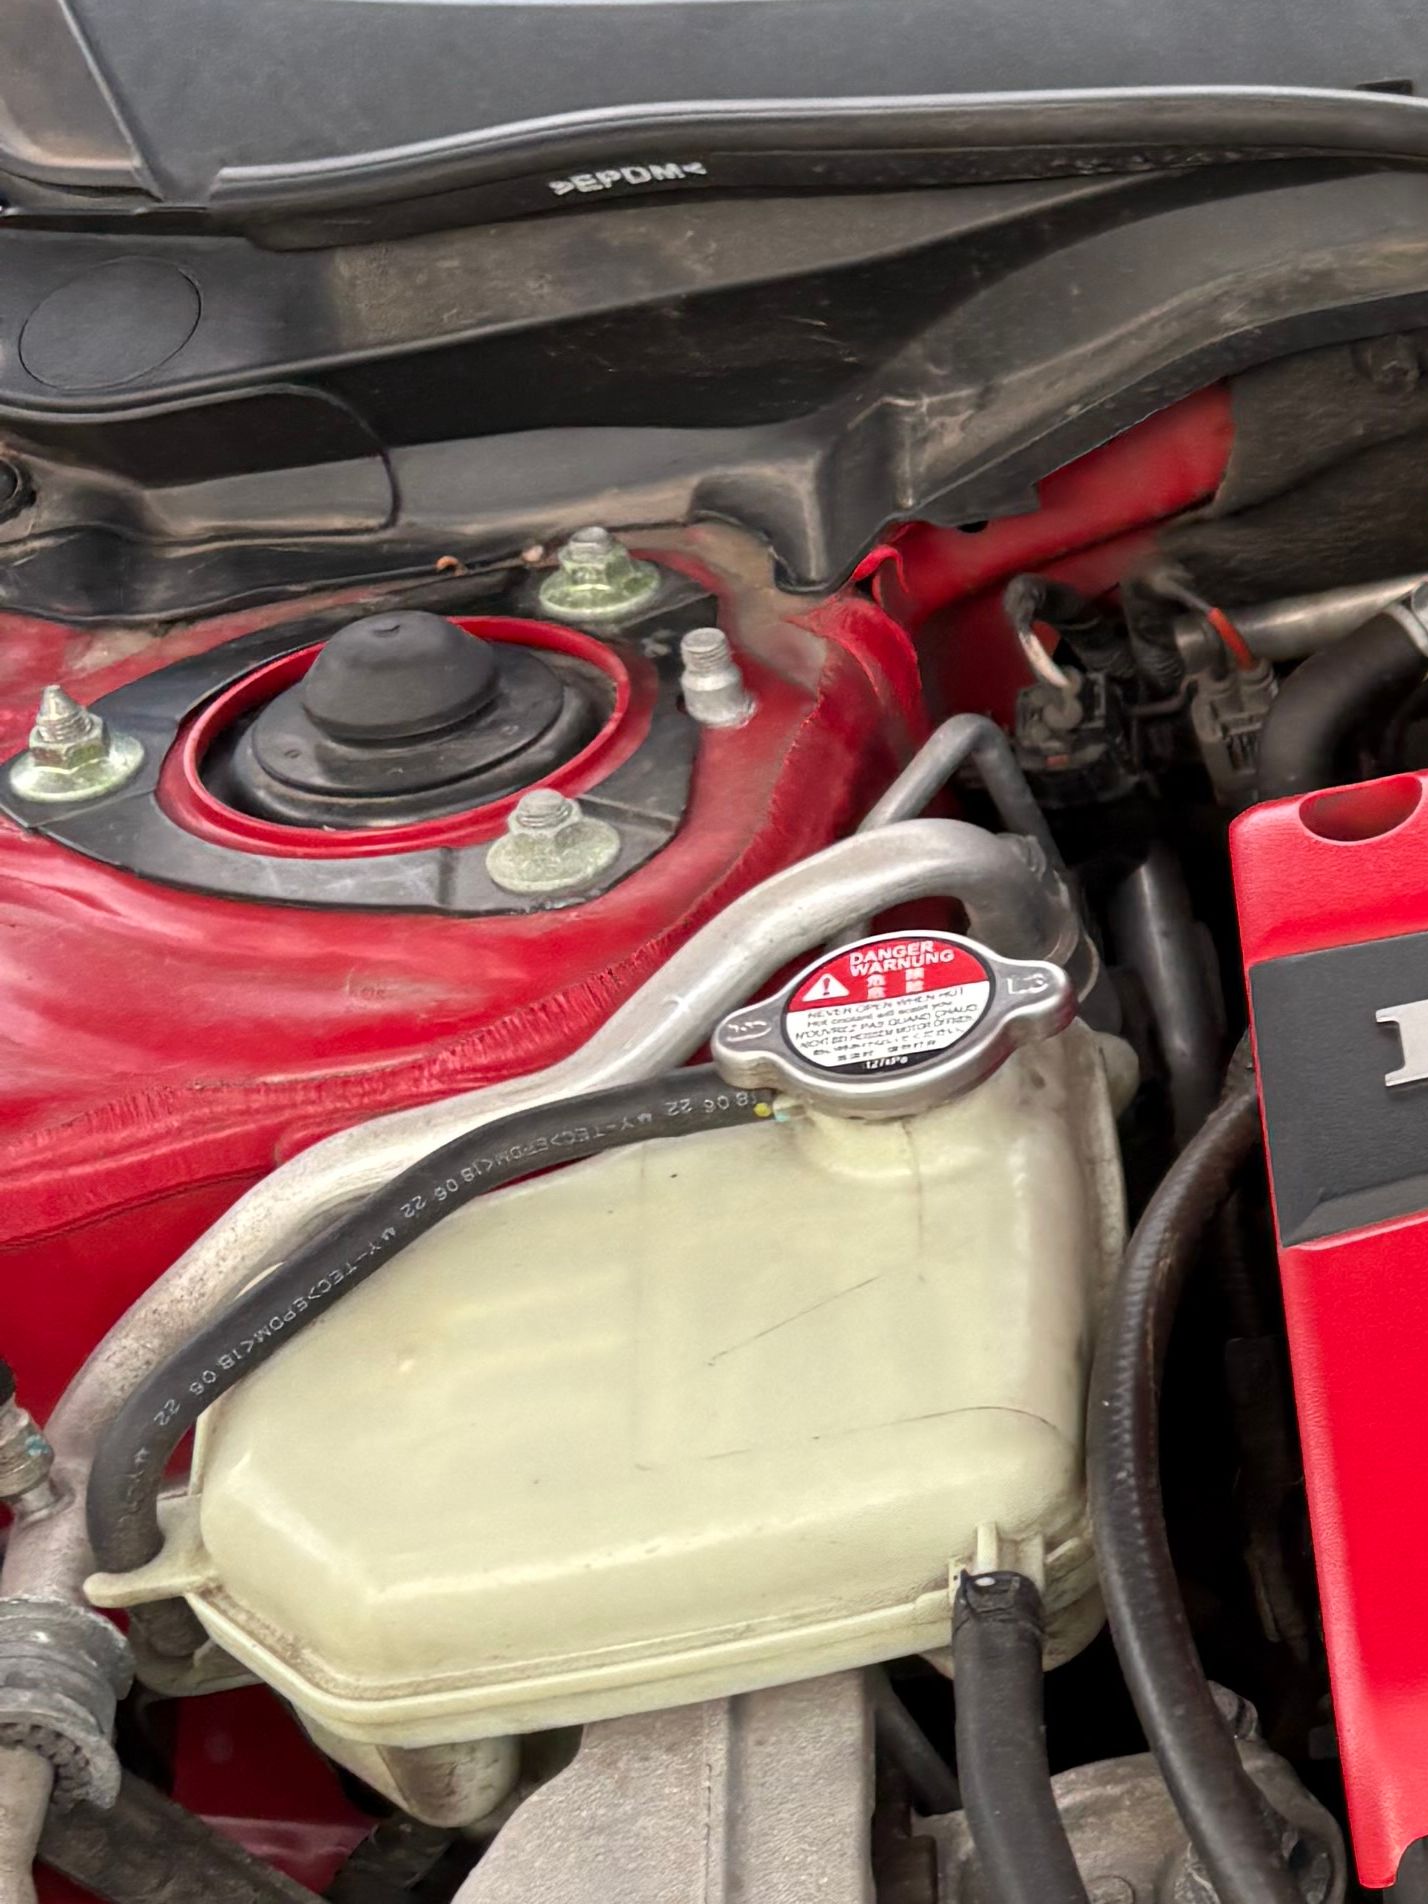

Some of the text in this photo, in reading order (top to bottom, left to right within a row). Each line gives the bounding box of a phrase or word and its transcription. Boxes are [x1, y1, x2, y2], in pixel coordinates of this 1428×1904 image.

[850, 940, 934, 966] DANGER
[850, 949, 955, 977] WARNUNG
[664, 1098, 693, 1117] 22
[399, 1194, 427, 1219] 22
[153, 1398, 181, 1427] 22
